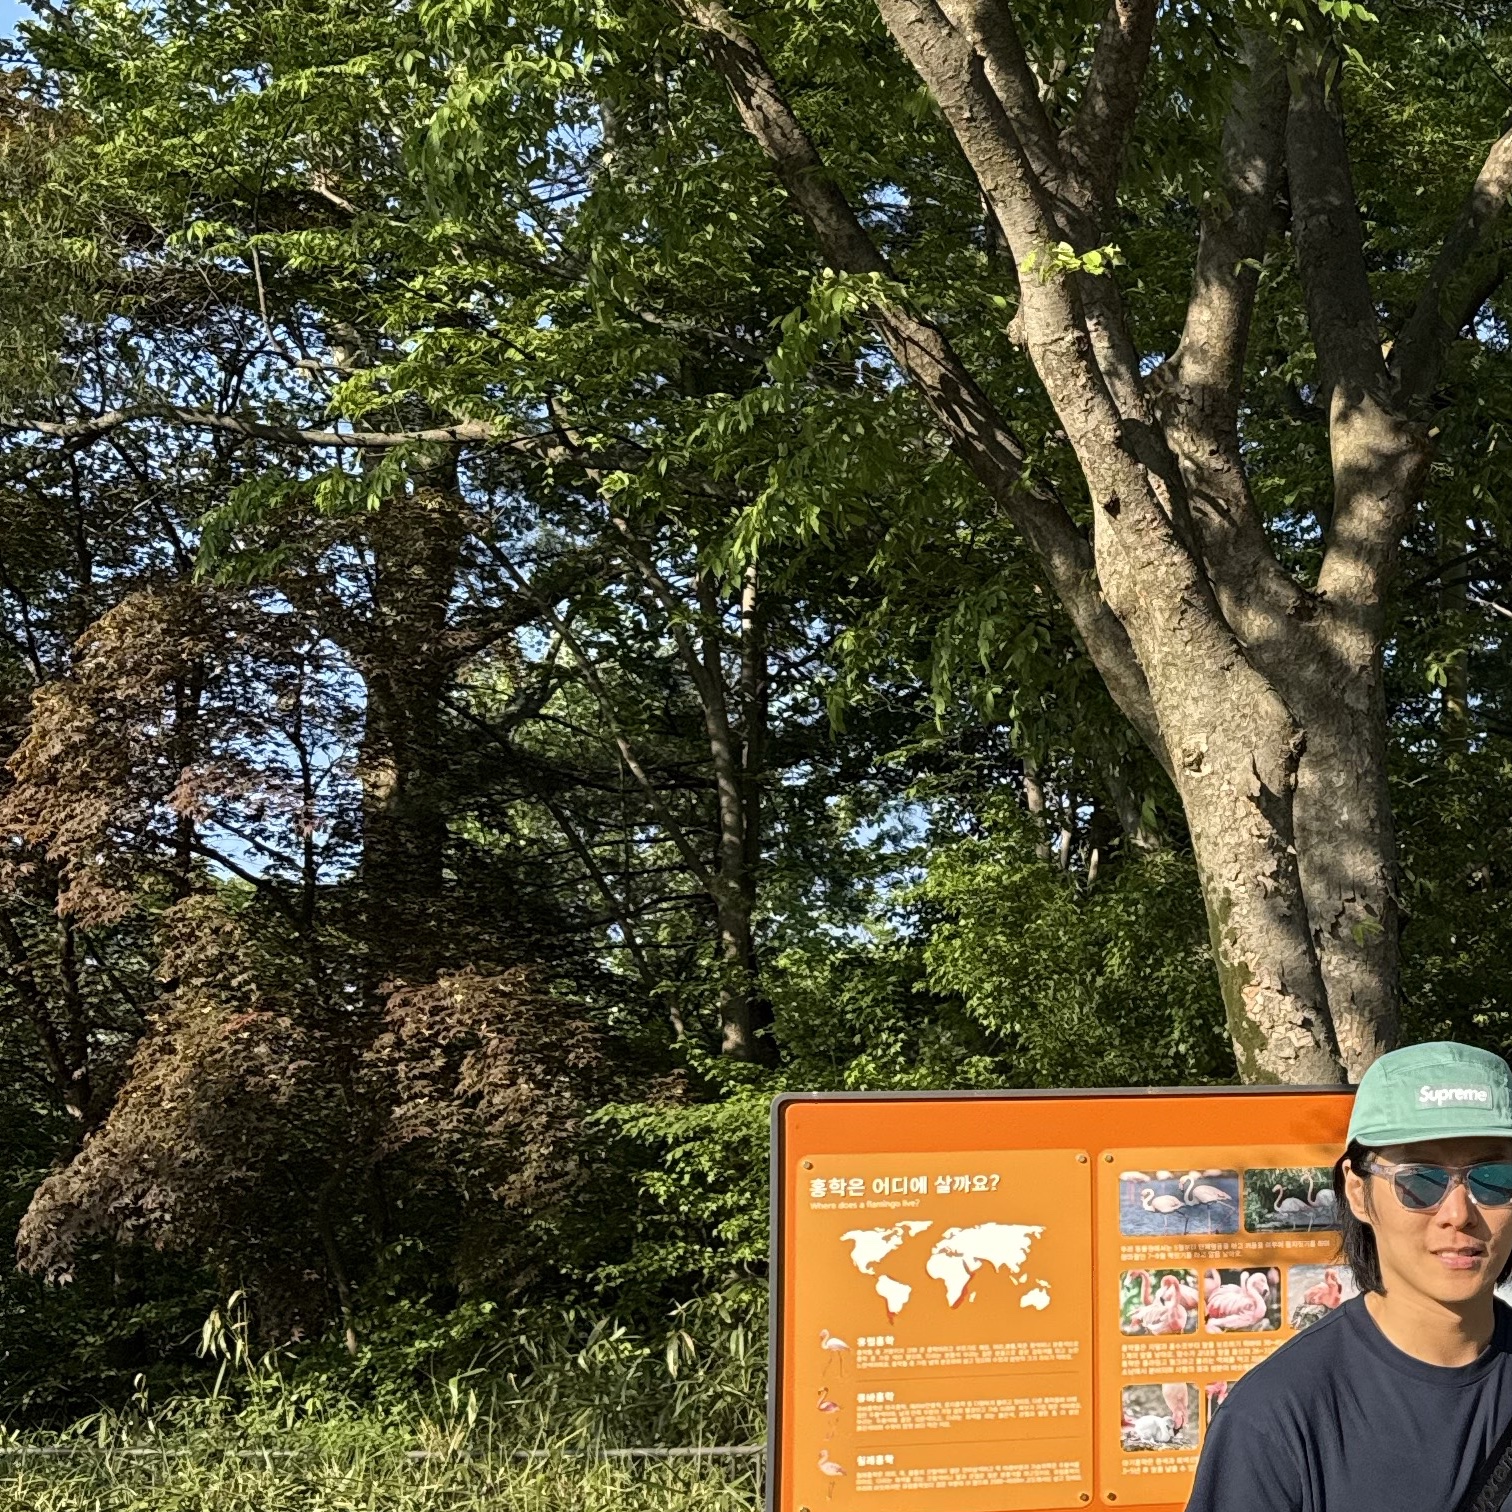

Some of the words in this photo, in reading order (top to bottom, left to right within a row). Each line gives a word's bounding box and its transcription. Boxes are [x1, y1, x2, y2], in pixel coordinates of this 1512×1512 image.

[1419, 1085, 1488, 1106] Supreme
[809, 1177, 866, 1198] 홍학은
[872, 1175, 928, 1195] 어디에
[934, 1174, 1000, 1194] 살까요?
[810, 1201, 837, 1210] Where
[838, 1201, 858, 1209] does
[866, 1199, 901, 1210] flamingo
[902, 1199, 921, 1209] live?
